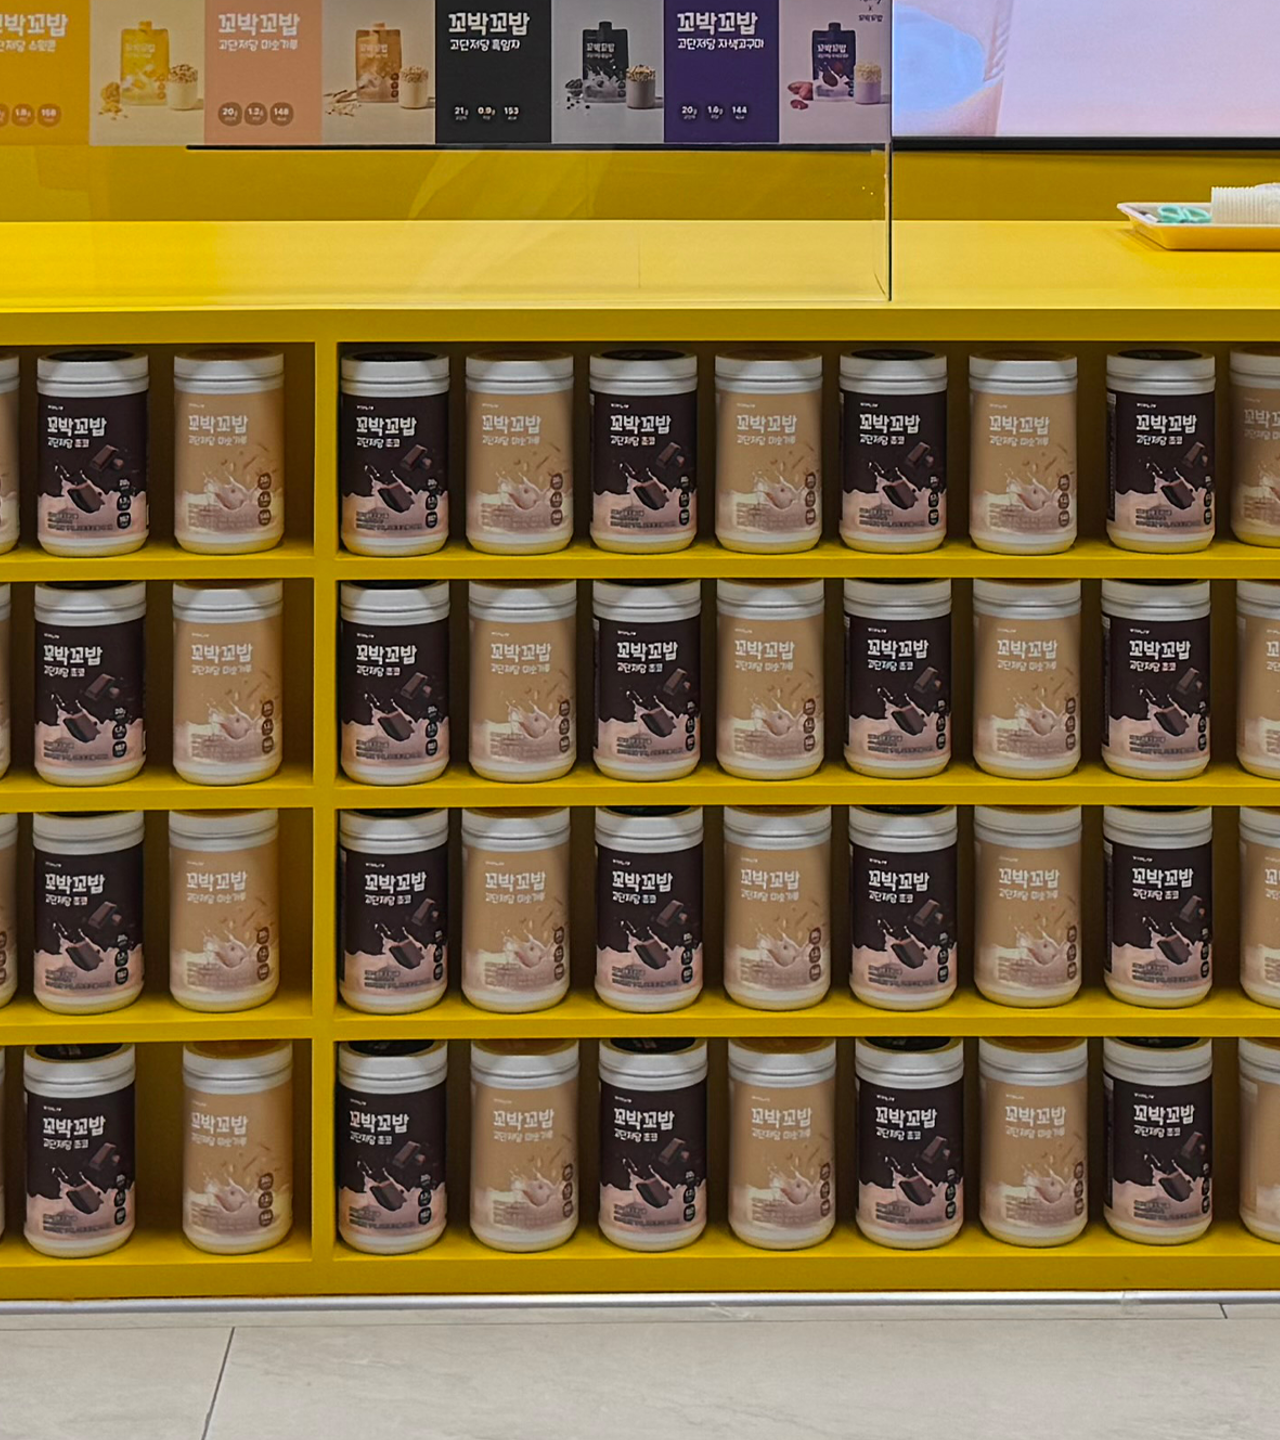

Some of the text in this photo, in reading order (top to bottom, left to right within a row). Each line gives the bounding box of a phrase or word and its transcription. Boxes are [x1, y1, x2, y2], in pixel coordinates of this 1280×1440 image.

[218, 13, 300, 36] 꼬박꼬밥
[448, 13, 531, 36] 꼬박꼬밥
[677, 12, 758, 35] 꼬박꼬밥
[219, 40, 258, 52] 고단저당
[450, 39, 490, 52] 고단저당
[678, 39, 716, 51] 고단저당
[47, 416, 107, 437] 꼬박꼬밥
[356, 416, 417, 437] 꼬박꼬밥
[610, 415, 671, 435] 꼬박꼬밥
[859, 413, 921, 434] 꼬박꼬밥
[1136, 414, 1197, 434] 꼬박꼬밥
[43, 644, 103, 666] 꼬박꼬밥
[356, 644, 417, 665] 꼬박꼬밥
[617, 641, 678, 662] 꼬박꼬밥
[867, 639, 929, 660] 꼬박꼬밥
[1129, 640, 1191, 660] 꼬박꼬밥
[45, 873, 105, 895] 꼬박꼬밥
[365, 871, 427, 894] 꼬박꼬밥
[612, 871, 673, 892] 꼬박꼬밥
[868, 870, 930, 892] 꼬박꼬밥
[1132, 868, 1194, 889] 꼬박꼬밥
[350, 1111, 409, 1134] 꼬박꼬밥
[614, 1108, 675, 1131] 꼬박꼬밥
[875, 1106, 937, 1129] 꼬박꼬밥
[1133, 1104, 1195, 1126] 꼬박꼬밥
[43, 1115, 106, 1139] 꼬박꼬밥
